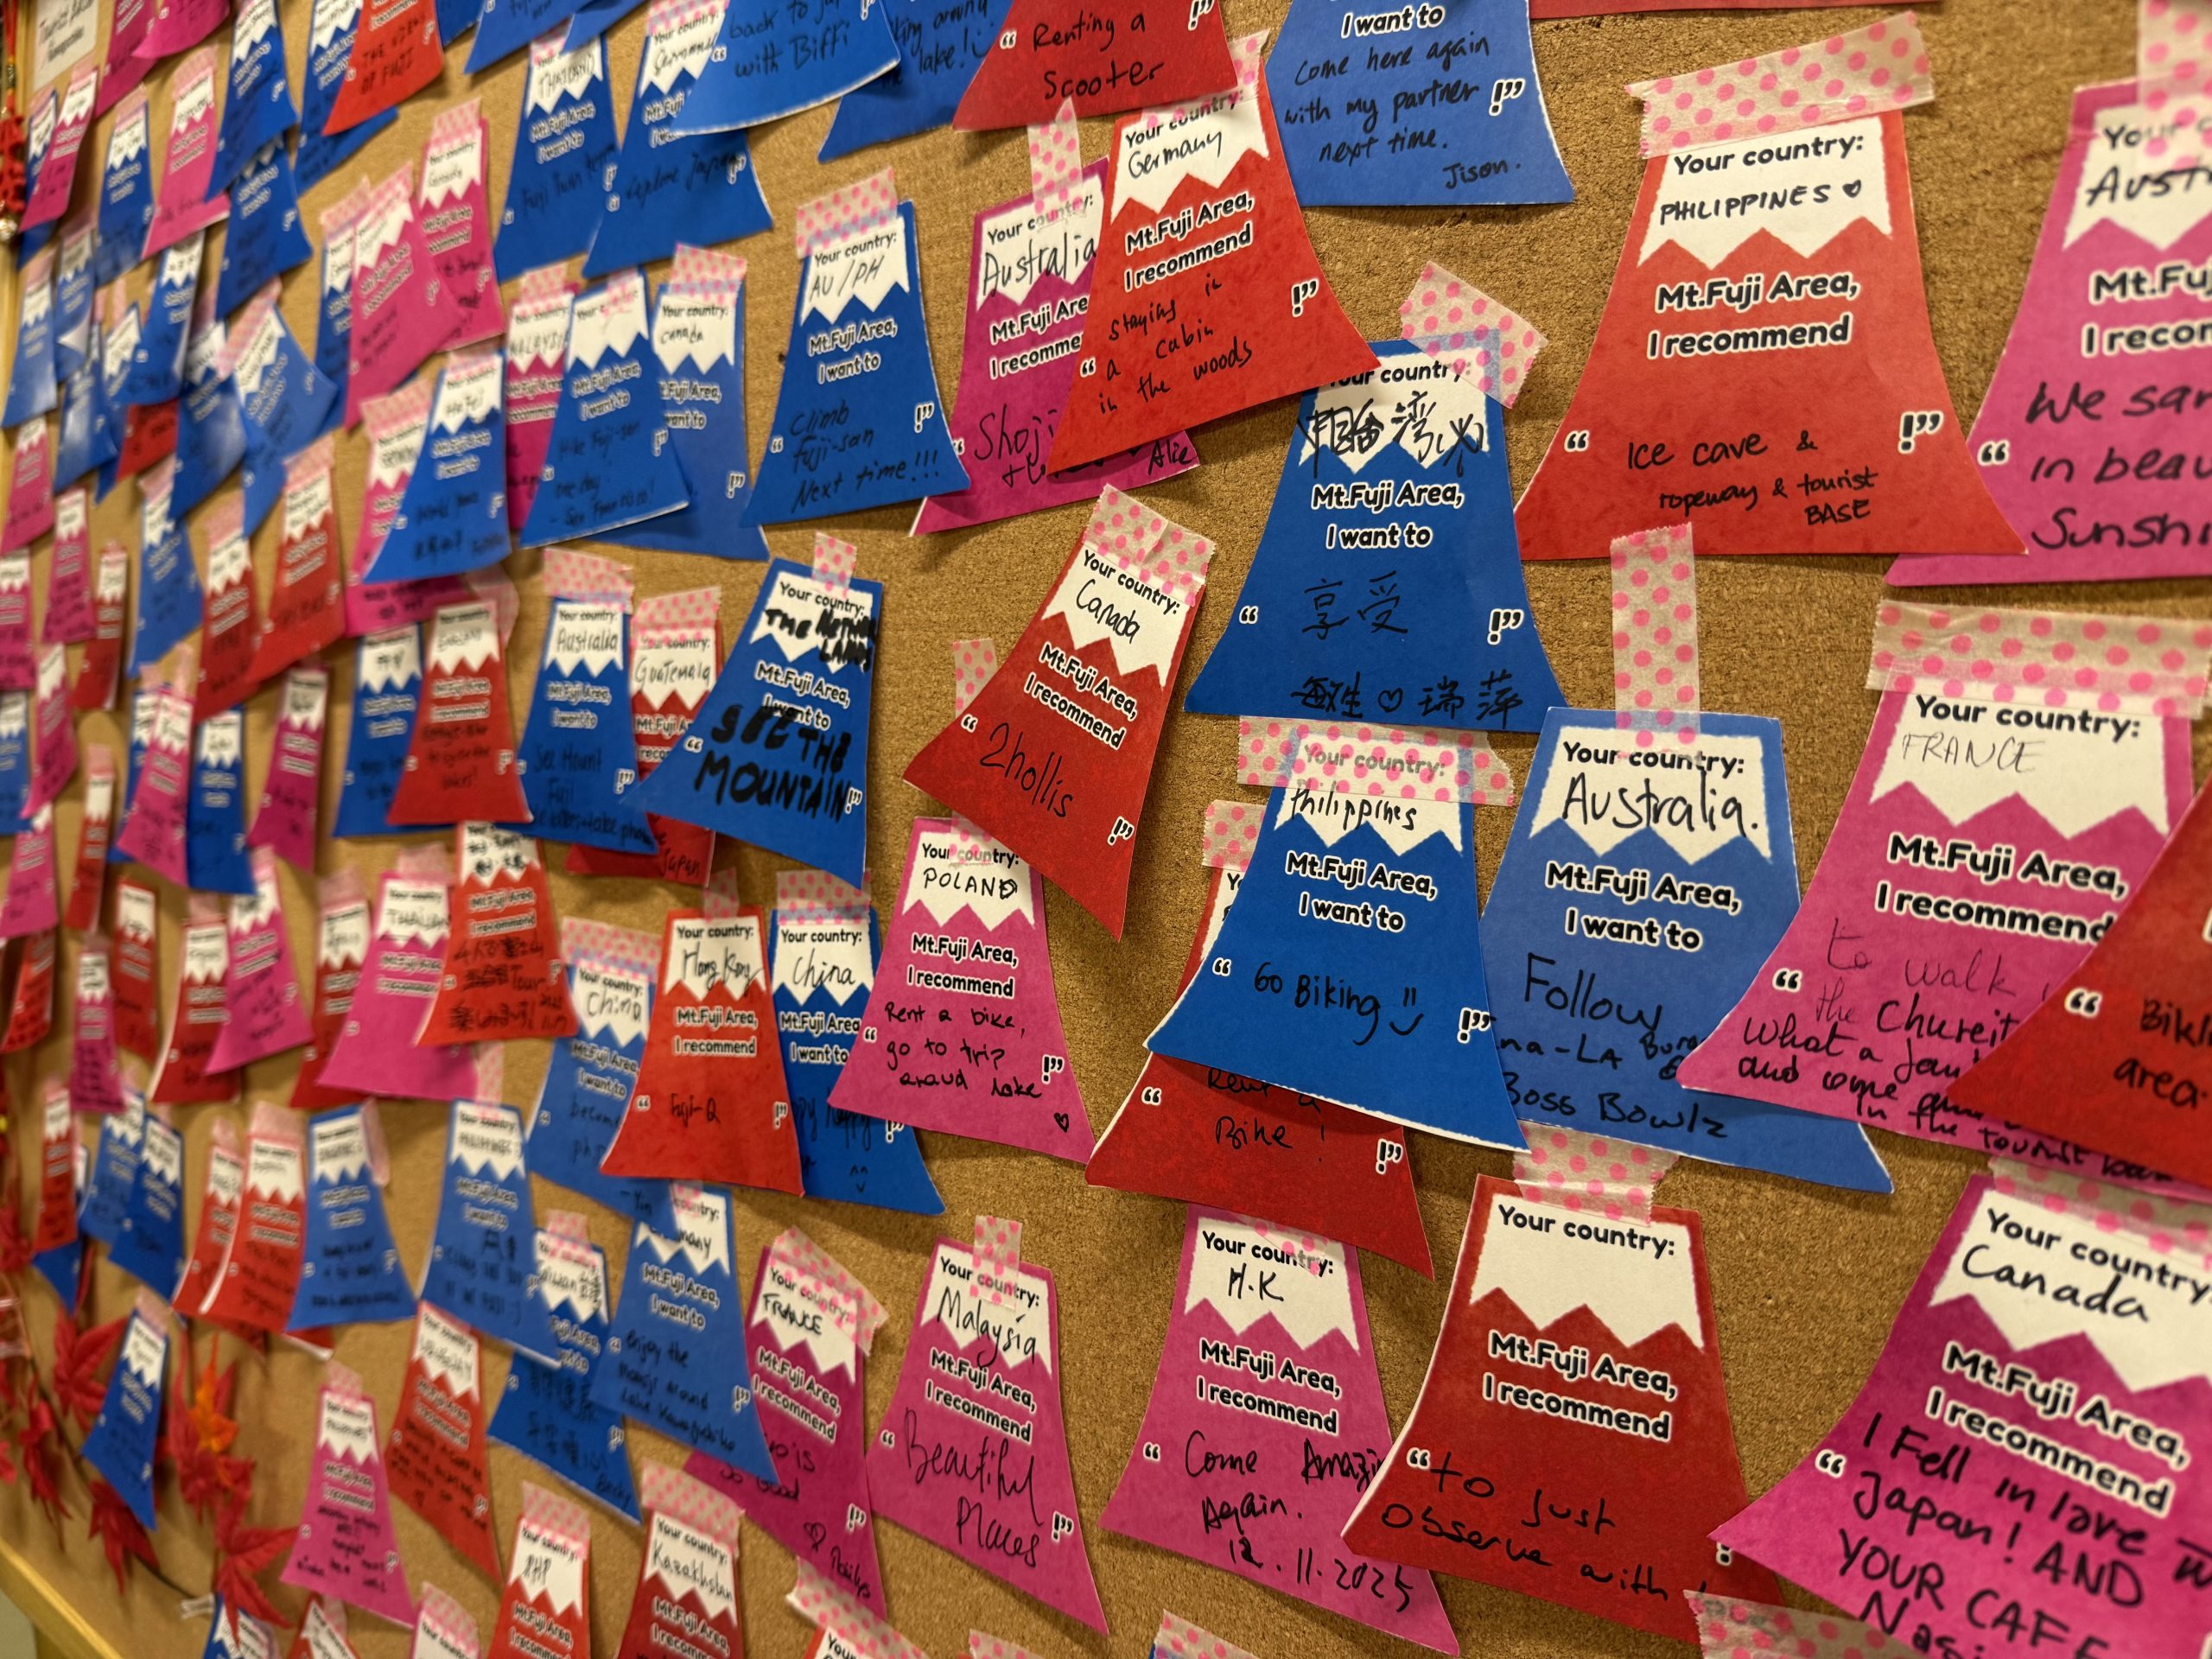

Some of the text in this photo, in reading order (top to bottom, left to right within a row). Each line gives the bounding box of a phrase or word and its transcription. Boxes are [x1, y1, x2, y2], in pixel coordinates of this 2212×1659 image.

[1033, 13, 1146, 53] Renting a
[1357, 11, 1413, 34] want
[1418, 7, 1444, 28] to
[1044, 60, 1164, 99] Scooter
[1295, 33, 1490, 85] Come here again
[1126, 89, 1243, 149] Your country:
[1285, 79, 1479, 133] with my partner
[1128, 132, 1222, 181] Germany
[1319, 128, 1447, 166] next time.
[1675, 136, 1864, 175] Your country:
[1126, 193, 1254, 255] Mt.Fuji Area,
[982, 232, 1097, 296] Australia
[1136, 226, 1252, 286] recommend
[1657, 274, 1859, 310] Mt.Fuji Area,
[1156, 320, 1213, 359] cabin
[1649, 315, 1850, 356] I recommend
[1137, 372, 1170, 402] the
[1194, 337, 1252, 380] woods
[1693, 432, 1768, 467] cave
[1796, 430, 1818, 451] &
[1313, 482, 1463, 513] Mt.Fuji Area,
[1660, 467, 1879, 518] ropeway & tourist
[1805, 499, 1871, 526] BASE
[1328, 525, 1431, 548] I want to
[1083, 550, 1181, 616] Your country:
[1077, 578, 1140, 644] Canada
[1916, 694, 2141, 743] Your country:
[1562, 741, 1745, 779] Your country:
[1902, 732, 2046, 773] FRANCE
[1562, 772, 1758, 837] Australia.
[1287, 853, 1437, 899] Mt.Fuji Area,
[1548, 862, 1740, 913] Mt.Fuji Area,
[1890, 835, 2128, 899] Mt.Fuji Area,
[677, 925, 753, 940] Your country:
[1300, 893, 1404, 931] I want to
[1567, 909, 1700, 950] I want to
[781, 930, 862, 947] Your country:
[792, 949, 855, 988] China
[1524, 952, 1662, 1031] Follow
[1905, 948, 2016, 998] walk
[885, 1001, 926, 1022] Rent
[939, 1009, 952, 1022] a
[1294, 971, 1382, 1046] Biking
[887, 1038, 1005, 1071] go to trip
[1743, 1013, 1858, 1058] What
[1498, 1203, 1675, 1260] Your country:
[1961, 1244, 2150, 1324] Canada
[937, 1286, 1038, 1369] Malaysia
[1945, 1344, 2189, 1468] Mt.Fuji Area,
[1185, 1430, 1258, 1478] Come
[1891, 1426, 1971, 1484] Fell
[1995, 1478, 2037, 1513] in
[1928, 1389, 2172, 1515] I recommend
[1430, 1452, 1615, 1535] to just
[1580, 1563, 1669, 1601] with
[1839, 1529, 1946, 1611] YOUR
[2033, 1541, 2145, 1607] AND
